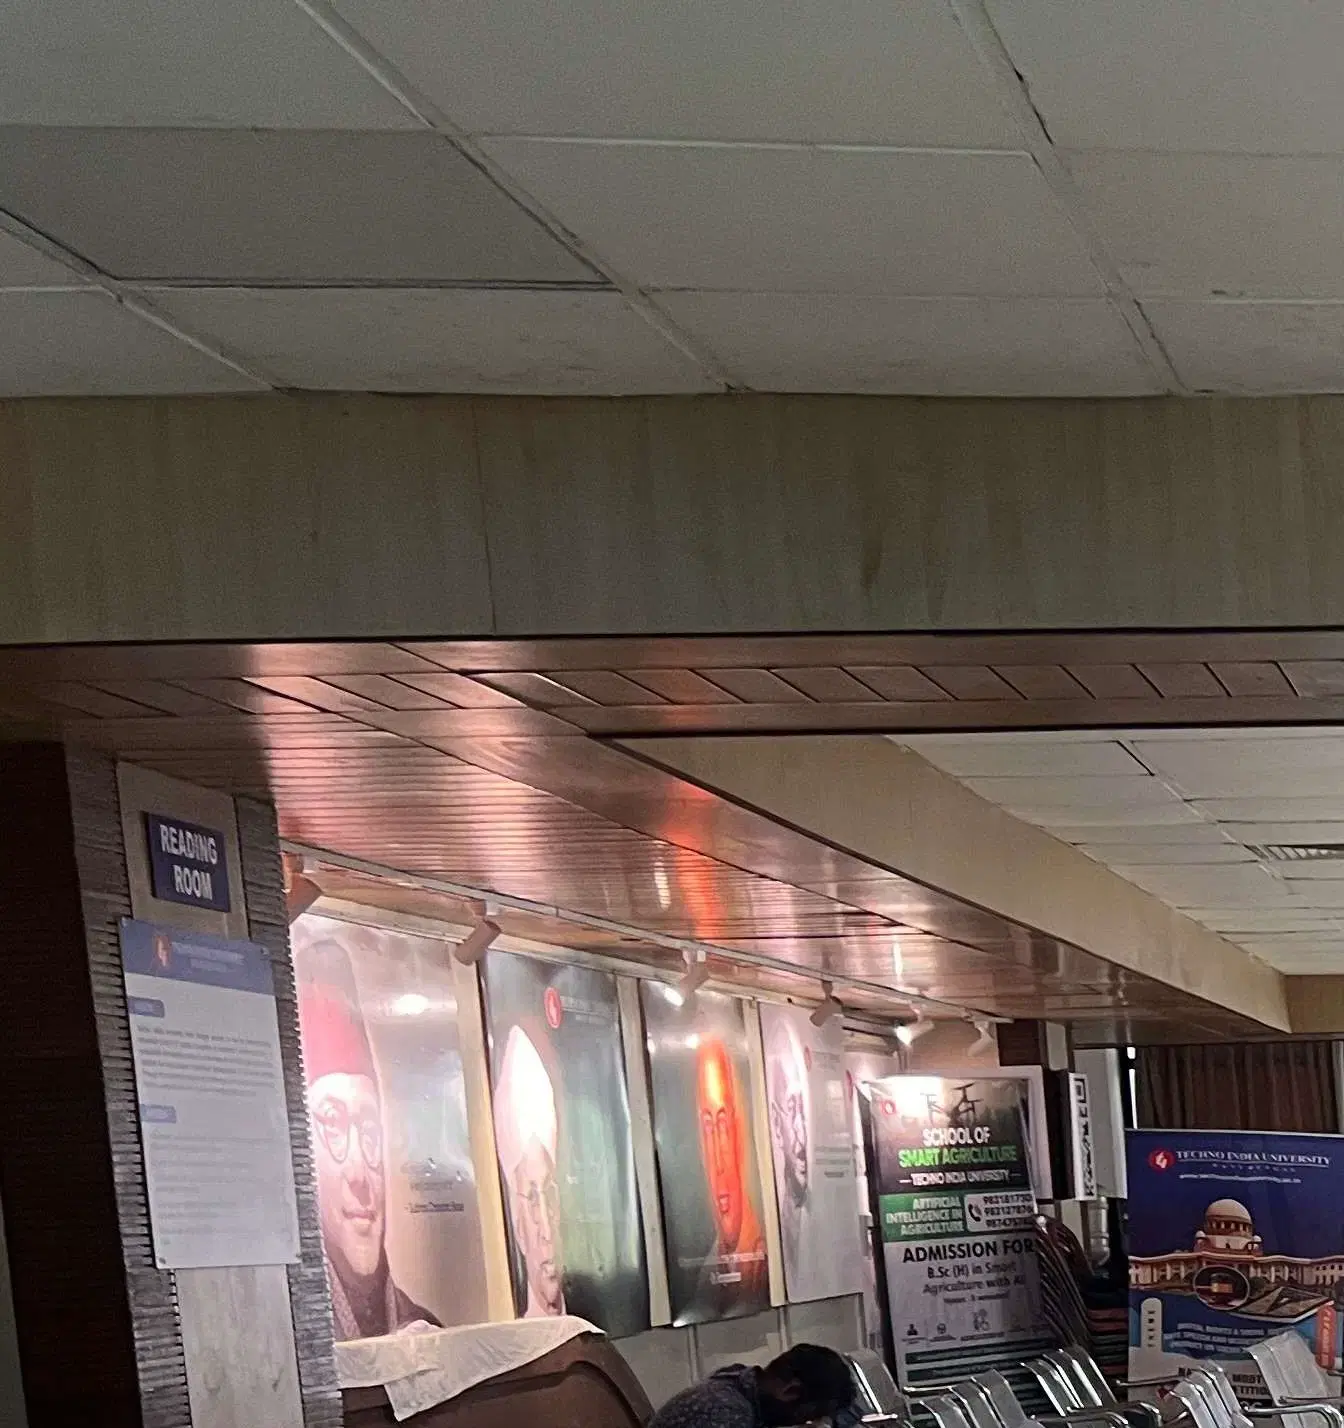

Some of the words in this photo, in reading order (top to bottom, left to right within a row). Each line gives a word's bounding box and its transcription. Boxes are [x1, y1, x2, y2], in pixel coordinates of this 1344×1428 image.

[159, 823, 218, 865] READING
[173, 864, 213, 900] ROOM
[922, 1127, 973, 1146] SCHOOL
[974, 1126, 990, 1144] OF
[898, 1147, 941, 1167] SMART
[943, 1145, 1017, 1165] AGRICULTURE
[1176, 1150, 1225, 1160] TECHNO
[1226, 1152, 1260, 1161] INDIA
[1260, 1153, 1330, 1165] UNIVERSITY
[911, 1172, 945, 1186] TECHNO
[967, 1169, 1010, 1182] UNIVERSITY
[913, 1196, 961, 1210] ARTIFICIAL
[886, 1210, 949, 1224] INTELLIGENCE
[900, 1221, 964, 1236] AGRICULTURE
[903, 1240, 997, 1263] ADMISSION
[1002, 1238, 1036, 1255] FOR
[928, 1266, 950, 1279] B.Sc
[953, 1264, 969, 1278] (H)
[972, 1263, 982, 1274] in
[922, 1281, 983, 1296] Agriculture
[986, 1276, 1010, 1288] with
